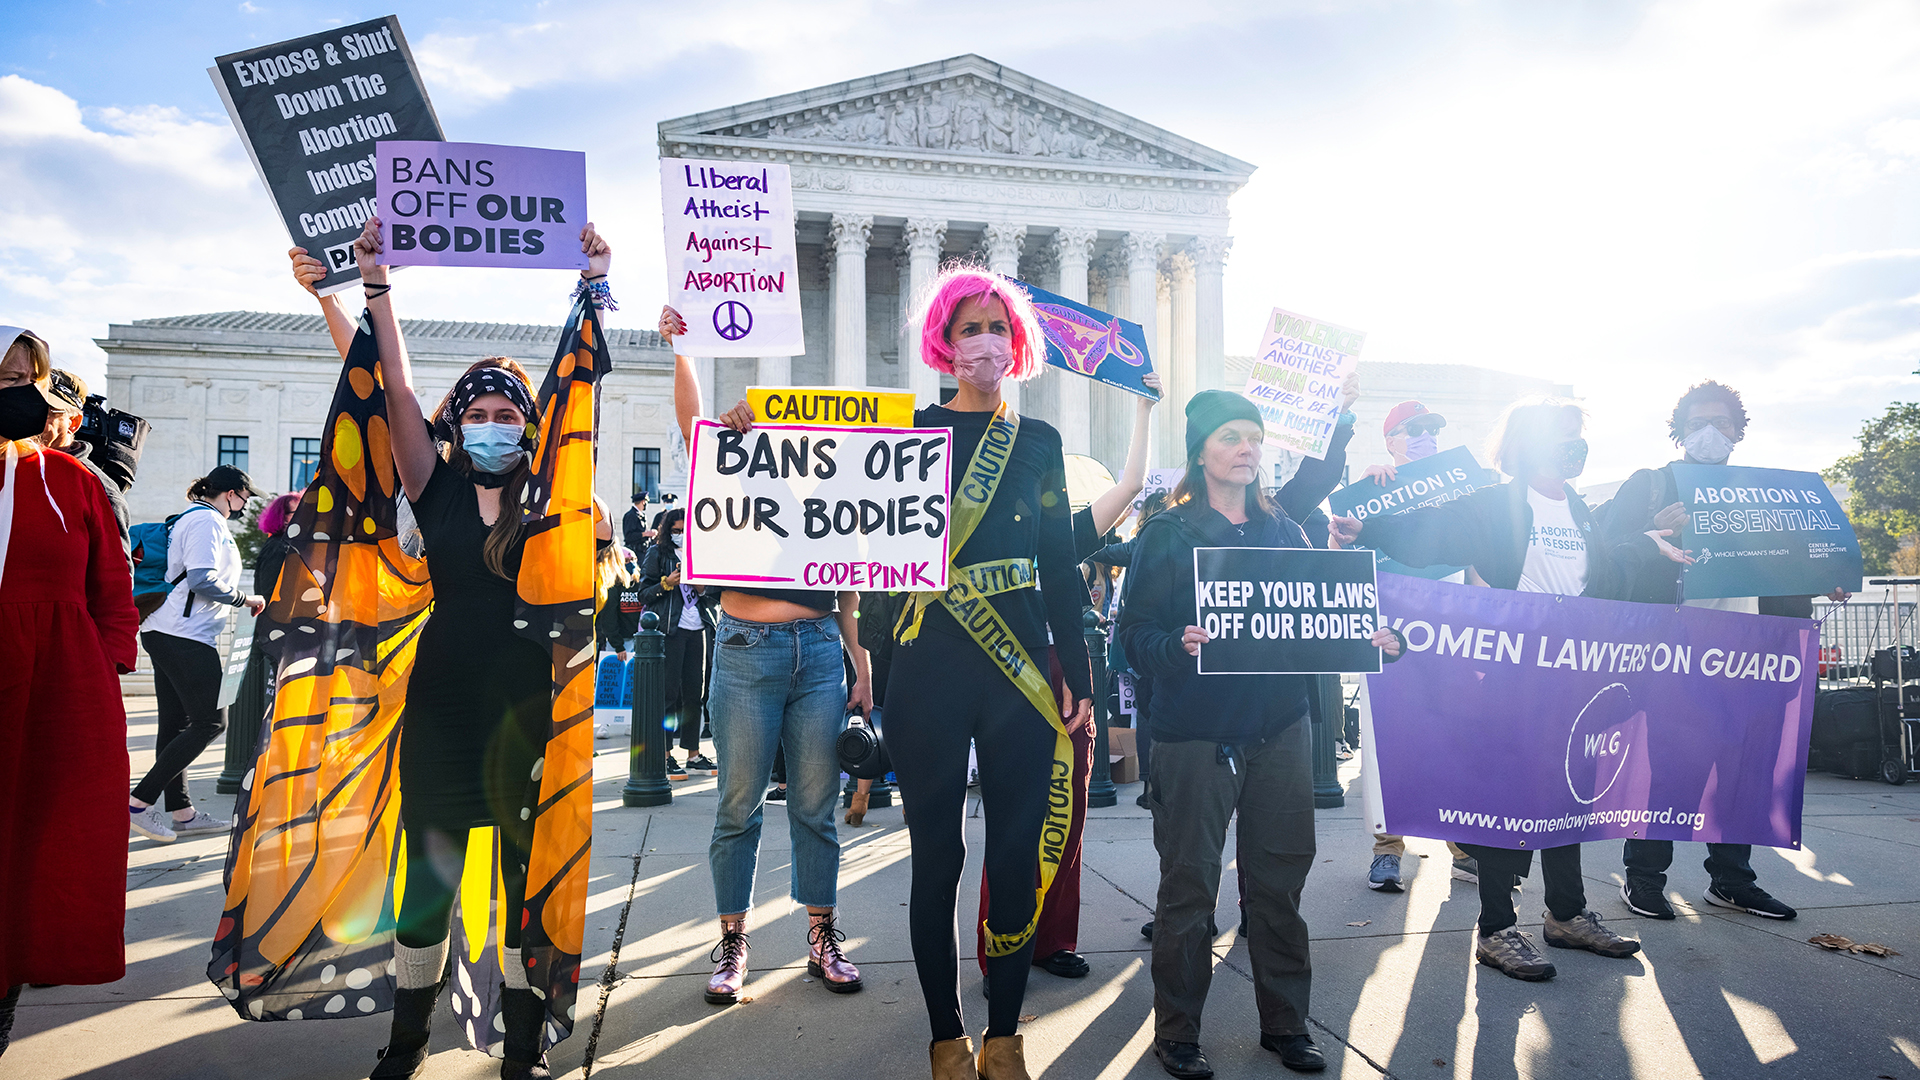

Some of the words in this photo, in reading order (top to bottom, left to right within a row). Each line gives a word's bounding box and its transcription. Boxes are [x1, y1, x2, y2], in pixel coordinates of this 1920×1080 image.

[233, 47, 320, 87] Expose
[322, 40, 340, 66] &
[340, 25, 397, 62] Shut
[275, 84, 344, 120] Down
[342, 73, 387, 104] The
[298, 111, 398, 156] Abortion
[392, 157, 495, 187] BANS
[863, 177, 915, 193] EQUAL
[920, 180, 978, 197] JUSTICE
[985, 186, 1037, 201] UNDER
[1040, 189, 1069, 202] LAW
[391, 190, 467, 218] OFF
[476, 193, 566, 224] OUR
[684, 196, 769, 221] Atheist
[391, 223, 545, 256] BODIES
[686, 230, 772, 263] Against
[1274, 312, 1363, 356] VIOLENCE
[1263, 349, 1340, 379] ANOTHER
[1270, 337, 1348, 366] AGAINST
[1251, 362, 1308, 395] HUMAN
[1308, 380, 1340, 400] CAN
[765, 394, 879, 423] CAUTION
[1250, 384, 1304, 410] NEVER
[1307, 400, 1329, 414] BE
[1327, 405, 1341, 419] A
[716, 429, 837, 480] BANS
[864, 436, 946, 482] OFF
[963, 413, 1016, 504] CAUTION
[1346, 474, 1445, 521] ABORTION
[1446, 467, 1467, 484] IS
[1694, 487, 1798, 504] ABORTION
[1800, 489, 1821, 505] IS
[694, 496, 789, 538] OUR
[803, 494, 946, 539] BODIES
[1693, 509, 1841, 534] ESSENTIAL
[1542, 537, 1552, 547] IS
[1714, 550, 1735, 558] WHOLE
[1737, 549, 1767, 557] WOMAN'S
[803, 560, 936, 589] CODEPINK
[1199, 581, 1254, 608] KEEP
[1260, 581, 1317, 608] YOUR
[1322, 582, 1376, 608] LAWS
[944, 582, 1027, 679] CAUTION
[1205, 612, 1244, 640] OFF
[1250, 612, 1295, 640] OUR
[1301, 613, 1374, 640] BODIES
[1537, 635, 1651, 674] LAWYERS
[1651, 642, 1691, 674] ON
[1700, 647, 1802, 683] GUARD
[1584, 729, 1621, 759] WLG
[1438, 806, 1705, 836] www.womenlawyersonguard.org
